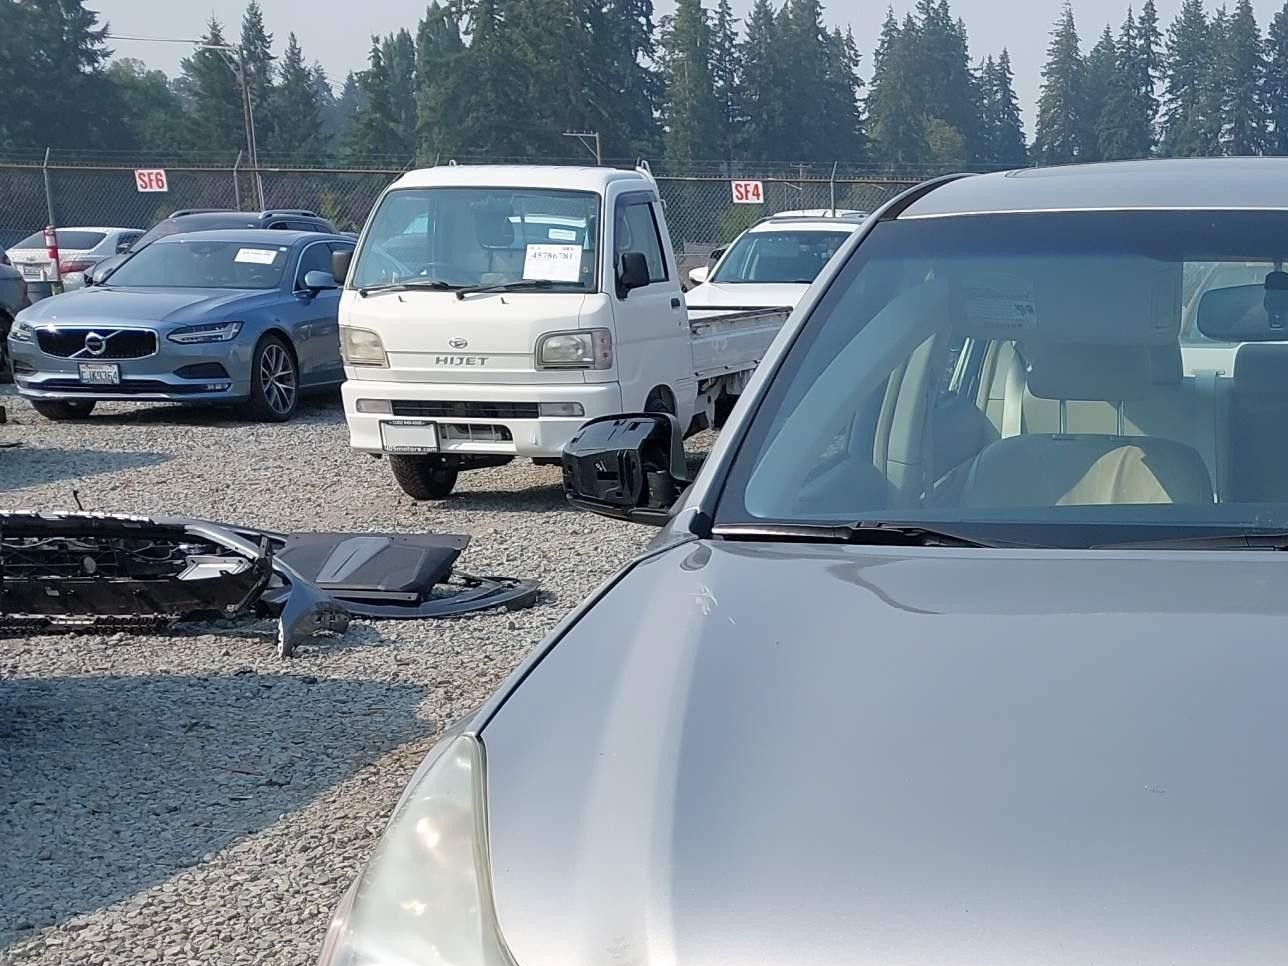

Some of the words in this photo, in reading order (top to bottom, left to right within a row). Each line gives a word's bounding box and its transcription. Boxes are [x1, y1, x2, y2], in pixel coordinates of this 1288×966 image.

[138, 172, 164, 189] SF6
[735, 183, 760, 200] SF4
[435, 356, 489, 366] HIJET
